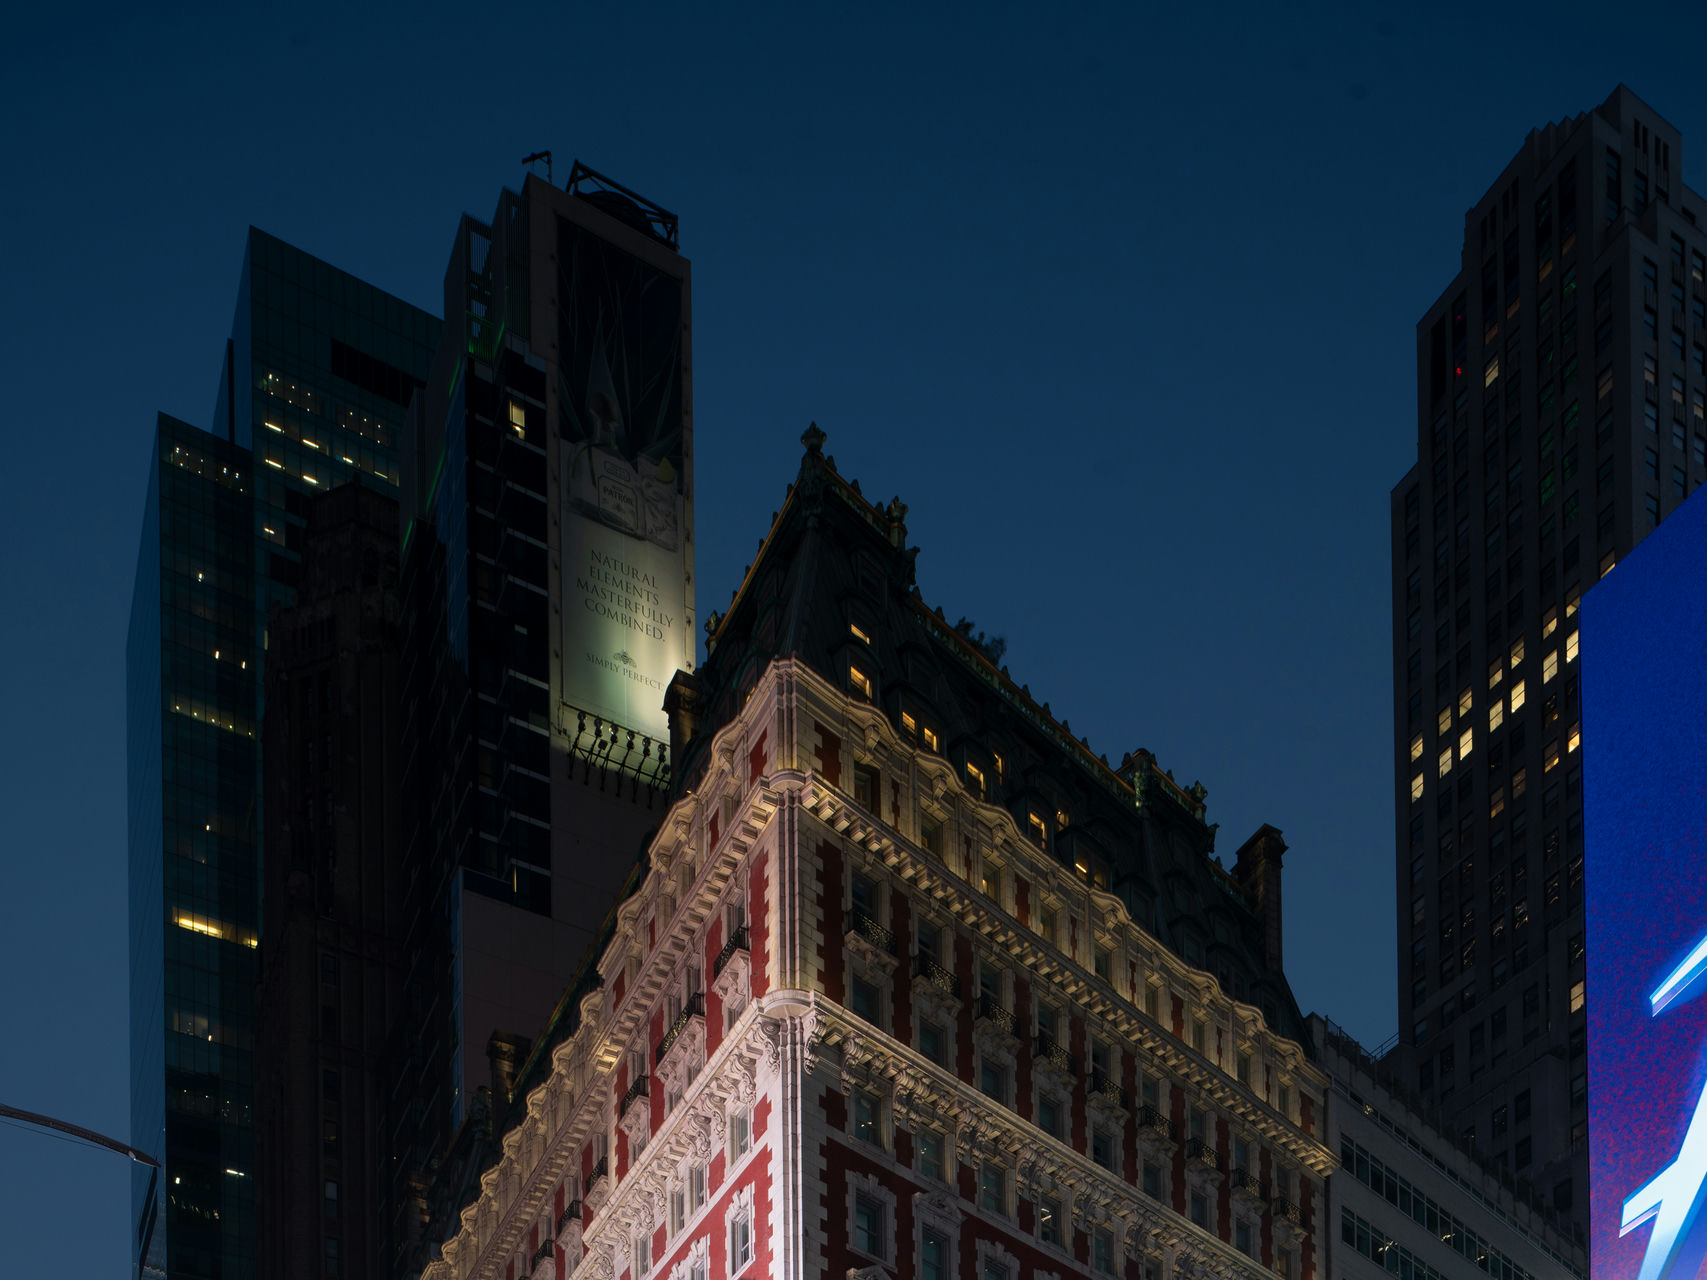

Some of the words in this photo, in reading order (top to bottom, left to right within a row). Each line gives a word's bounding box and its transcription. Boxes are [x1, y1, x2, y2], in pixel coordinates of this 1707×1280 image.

[590, 566, 659, 606] ELEMENTS
[591, 550, 658, 589] NATURAL
[577, 578, 673, 628] MASTERFULLY
[585, 598, 665, 642] COMBINED.
[585, 652, 619, 673] SIMPLY
